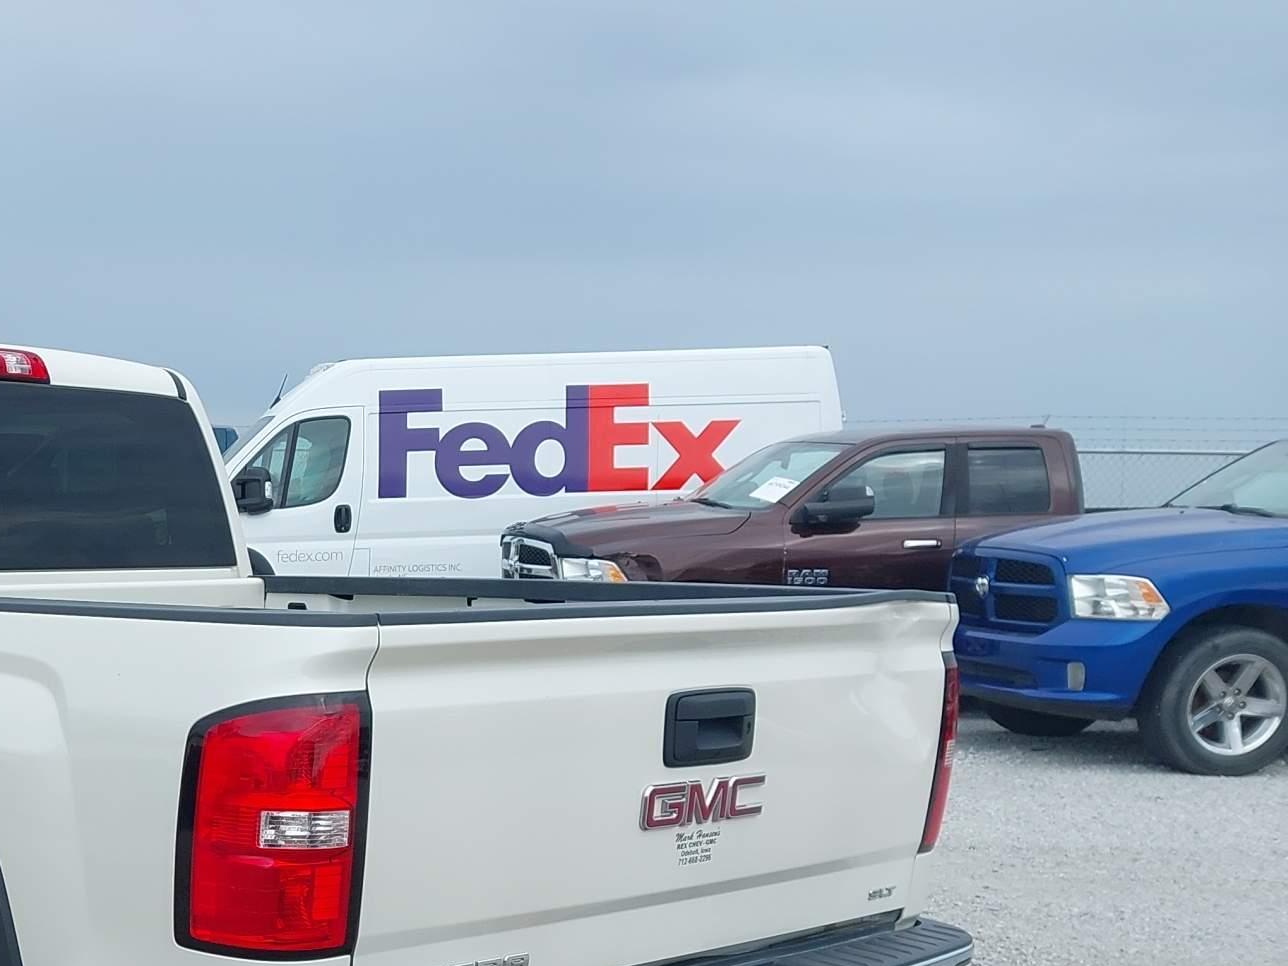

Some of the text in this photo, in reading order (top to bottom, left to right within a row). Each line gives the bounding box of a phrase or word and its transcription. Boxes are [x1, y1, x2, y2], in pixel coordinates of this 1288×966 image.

[378, 383, 741, 499] FedEx
[277, 549, 344, 563] fedex.com
[373, 565, 407, 573] AFFINITY
[408, 563, 448, 573] LOGISTICS
[639, 772, 767, 831] GMC
